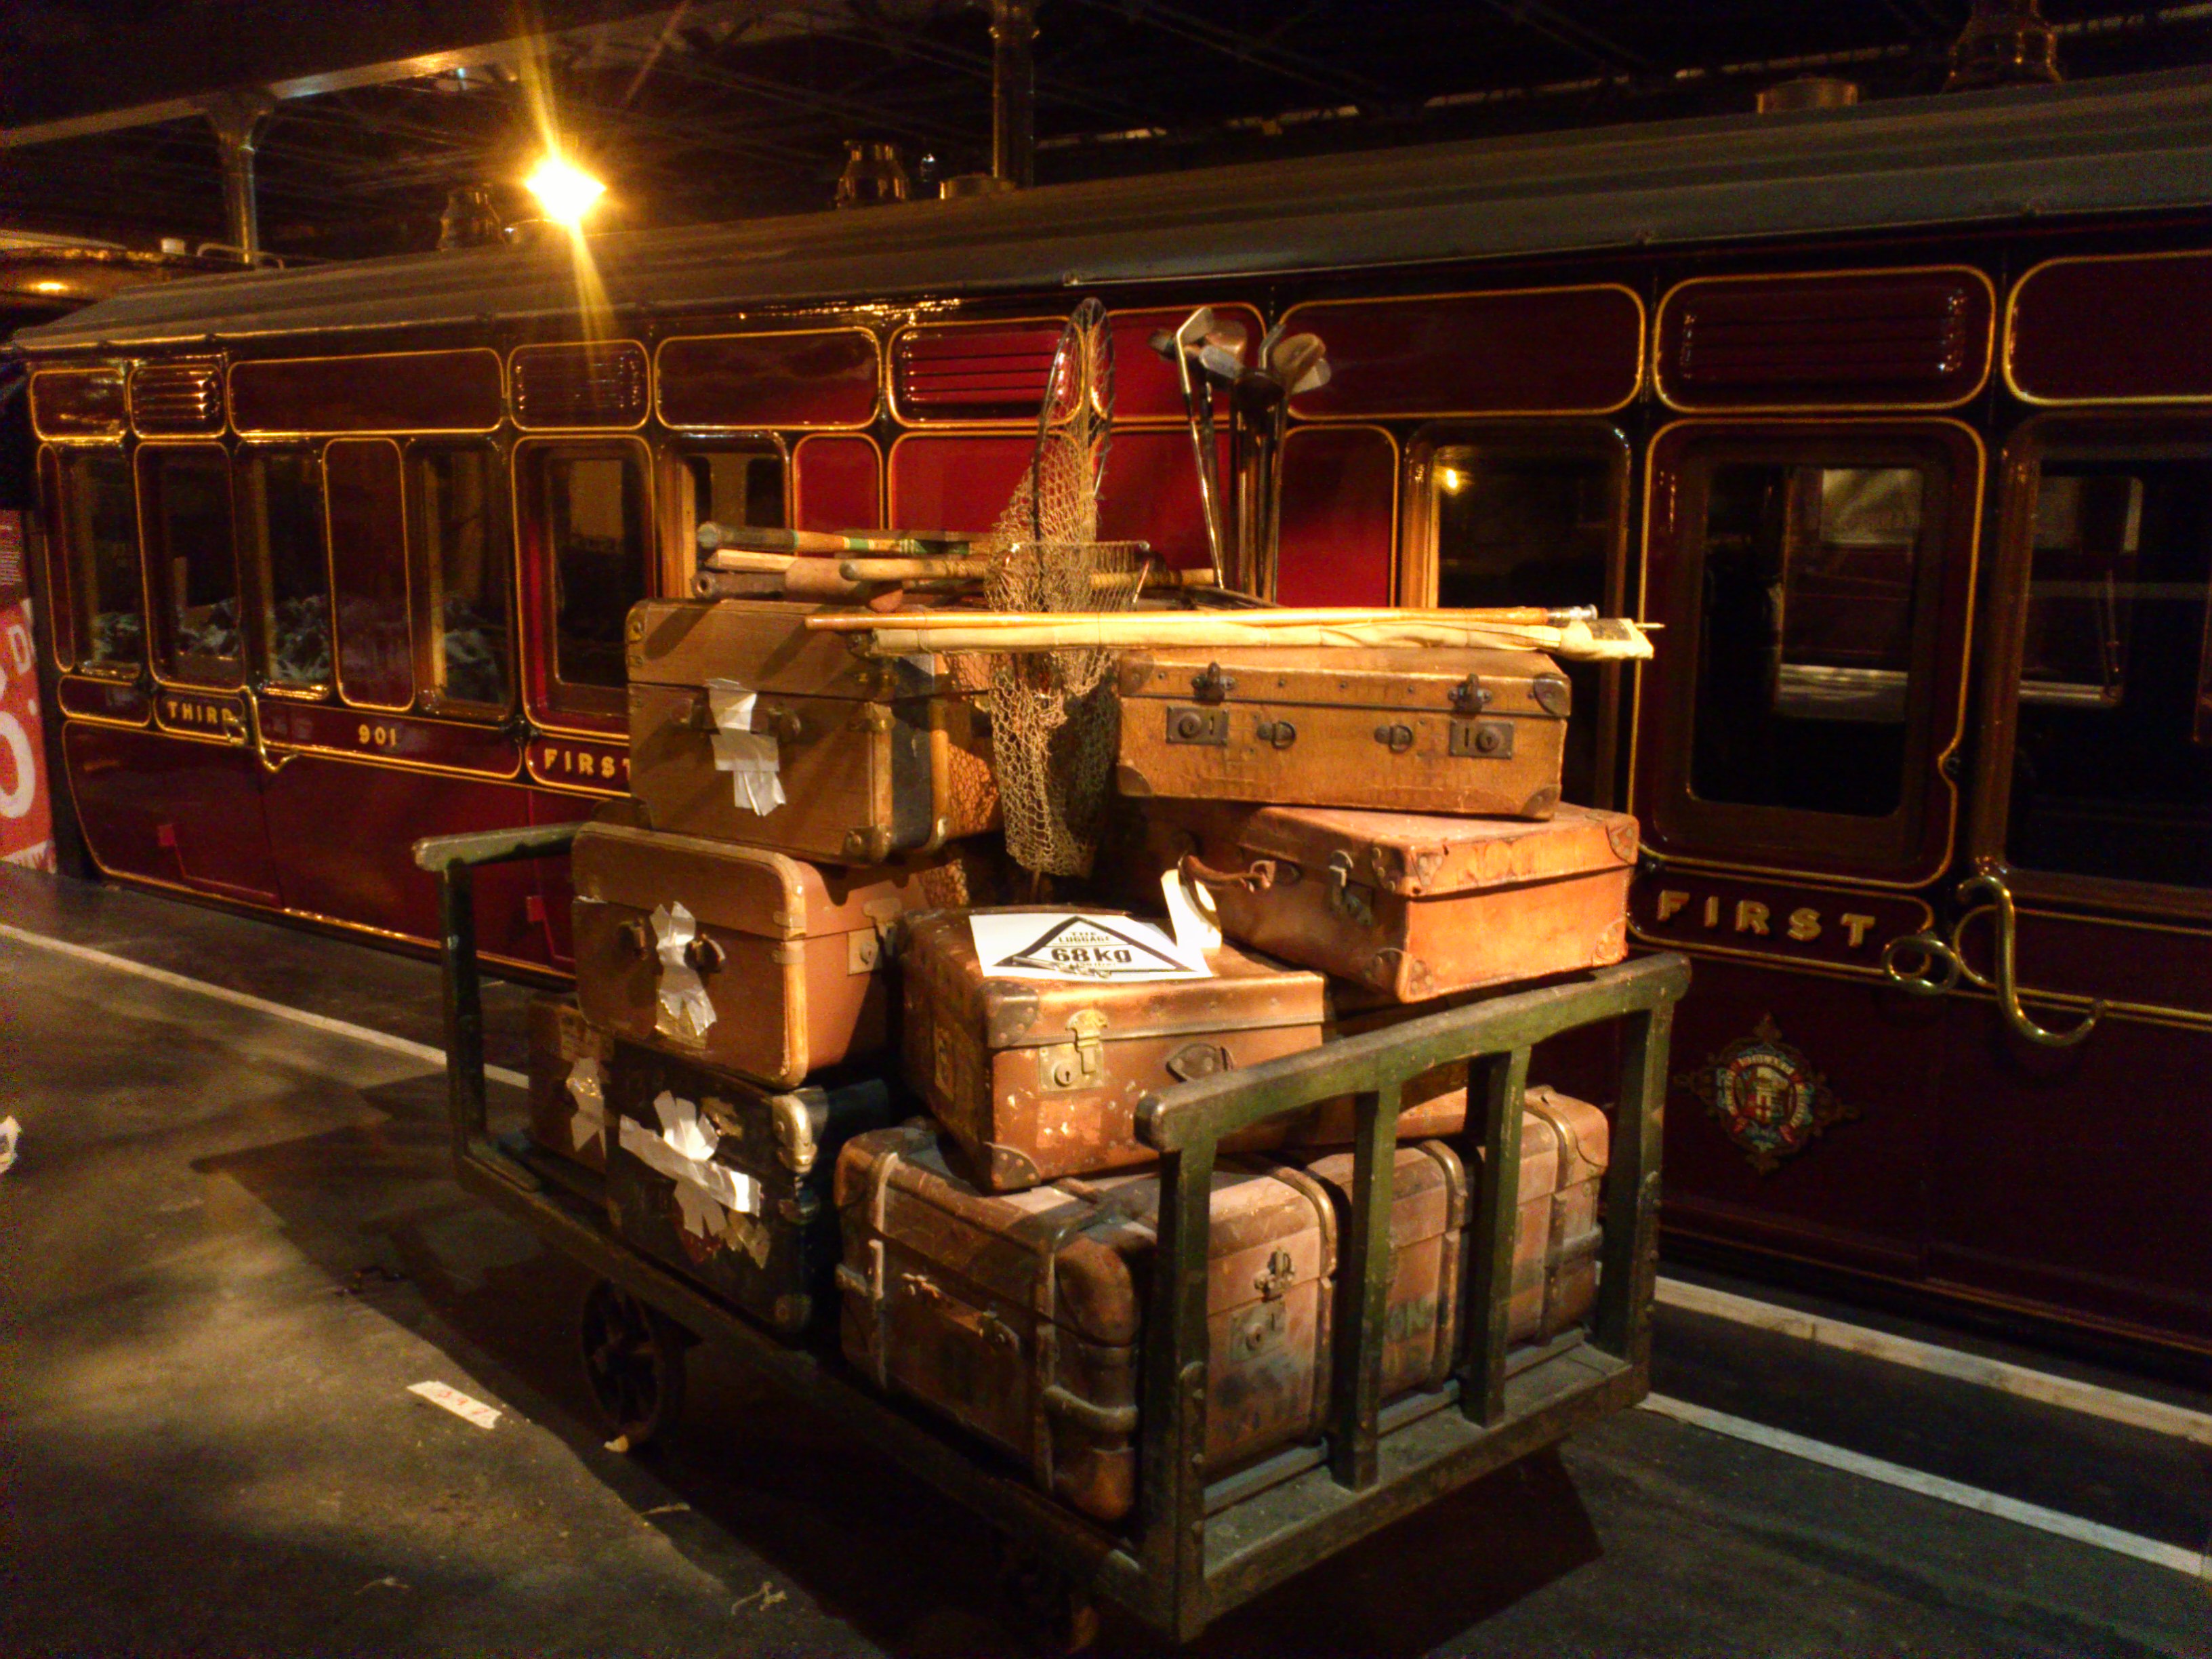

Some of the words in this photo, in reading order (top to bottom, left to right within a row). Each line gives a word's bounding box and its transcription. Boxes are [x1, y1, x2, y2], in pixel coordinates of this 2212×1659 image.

[167, 700, 234, 724] THIRD
[358, 723, 397, 747] 901
[1656, 888, 1877, 948] FIRST
